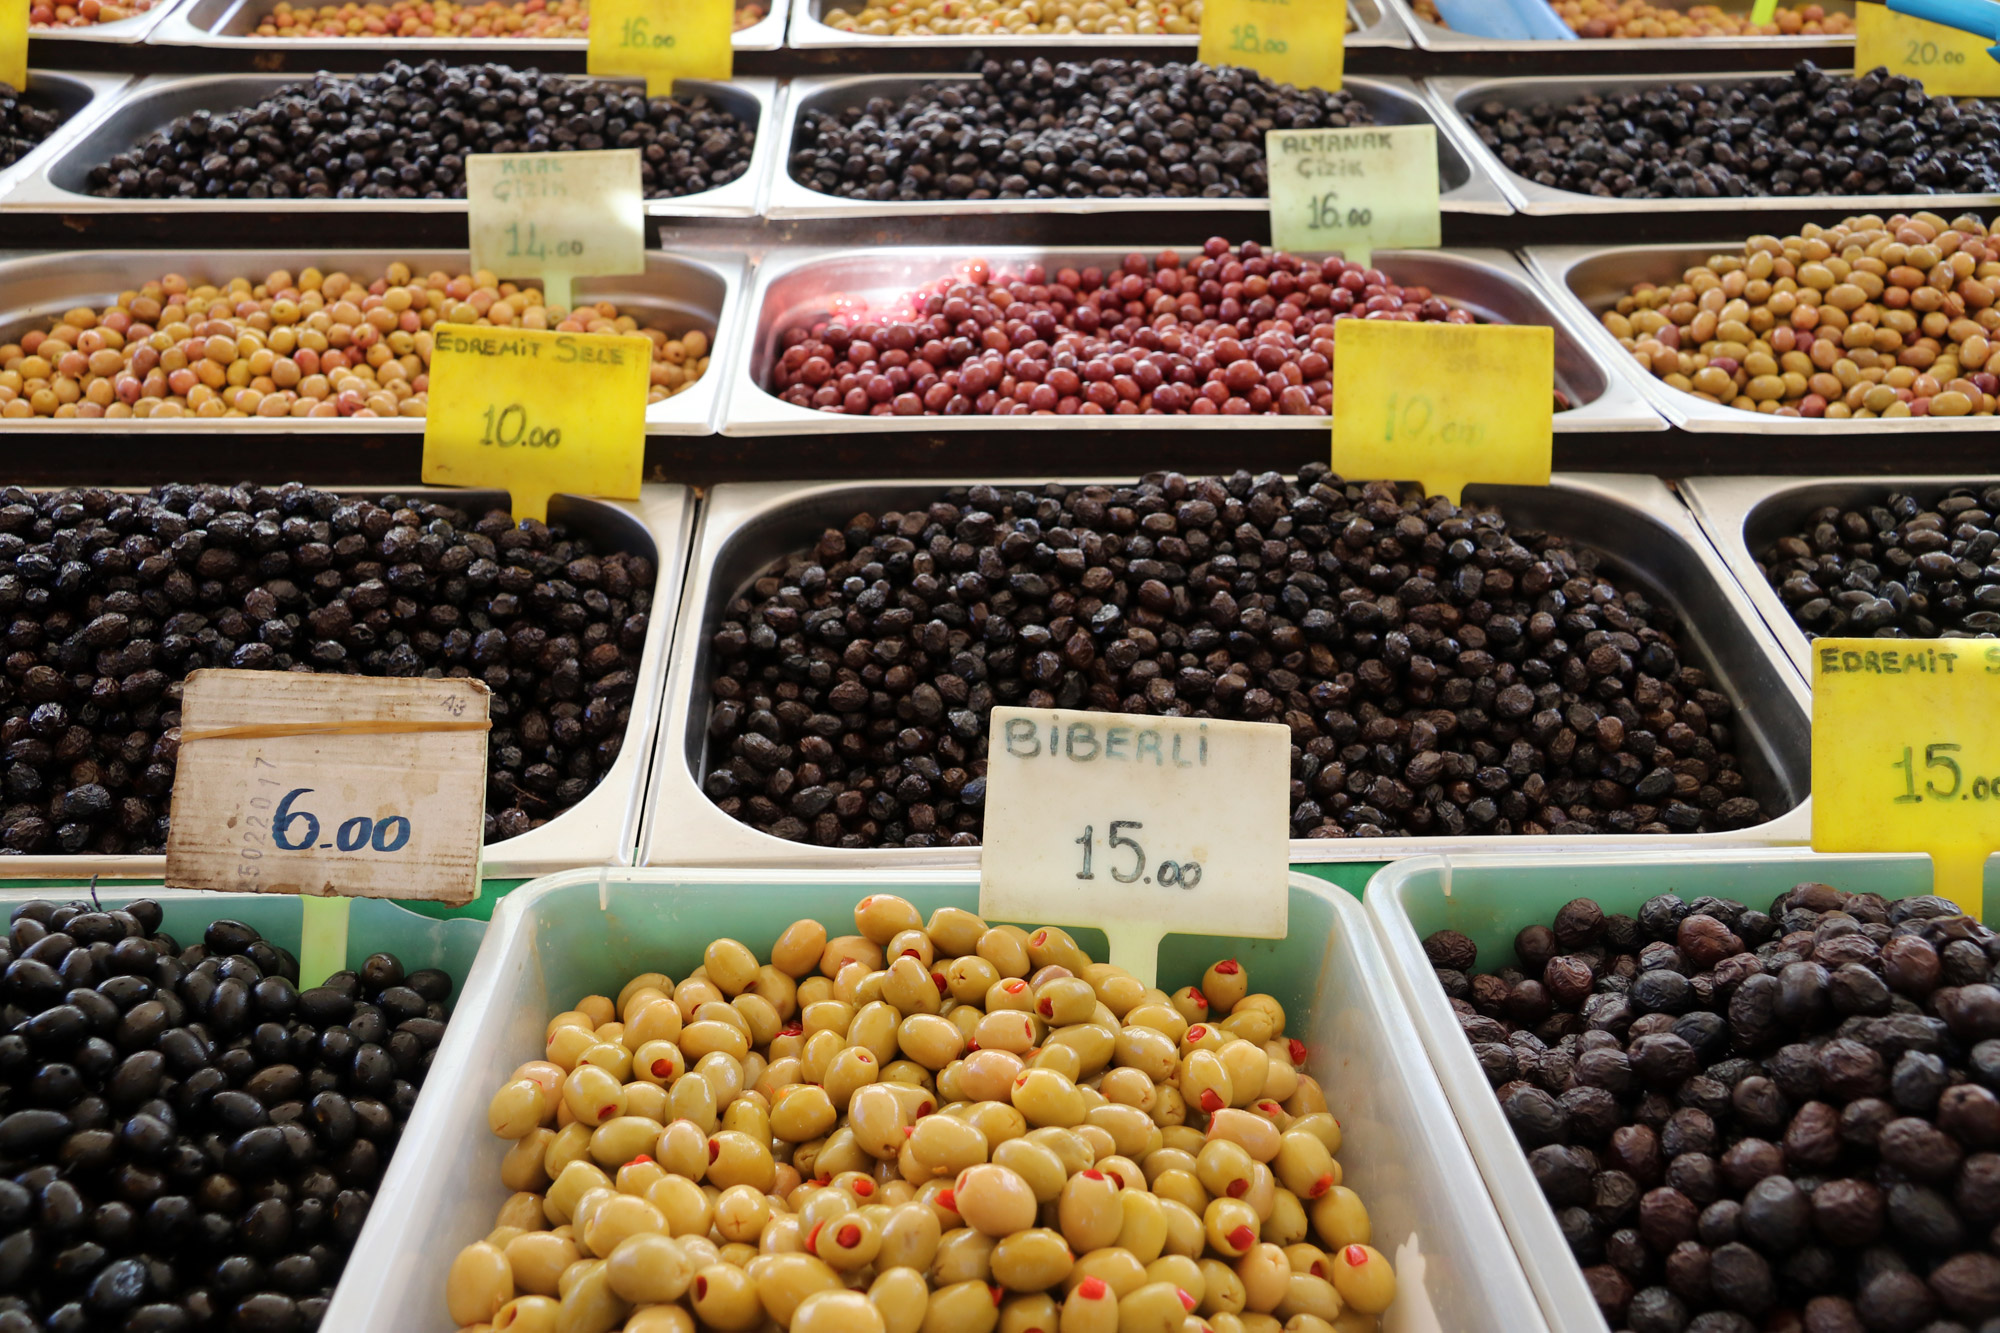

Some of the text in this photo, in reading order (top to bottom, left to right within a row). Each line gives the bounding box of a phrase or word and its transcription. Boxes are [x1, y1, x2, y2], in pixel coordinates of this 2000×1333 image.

[619, 16, 676, 48] 16.00
[1903, 39, 1965, 65] 20.00
[1281, 132, 1393, 153] ALMANAK
[1307, 191, 1372, 229] 16.00
[504, 221, 584, 262] 14.00
[479, 403, 561, 449] 10.00
[1075, 820, 1203, 890] 15.00
